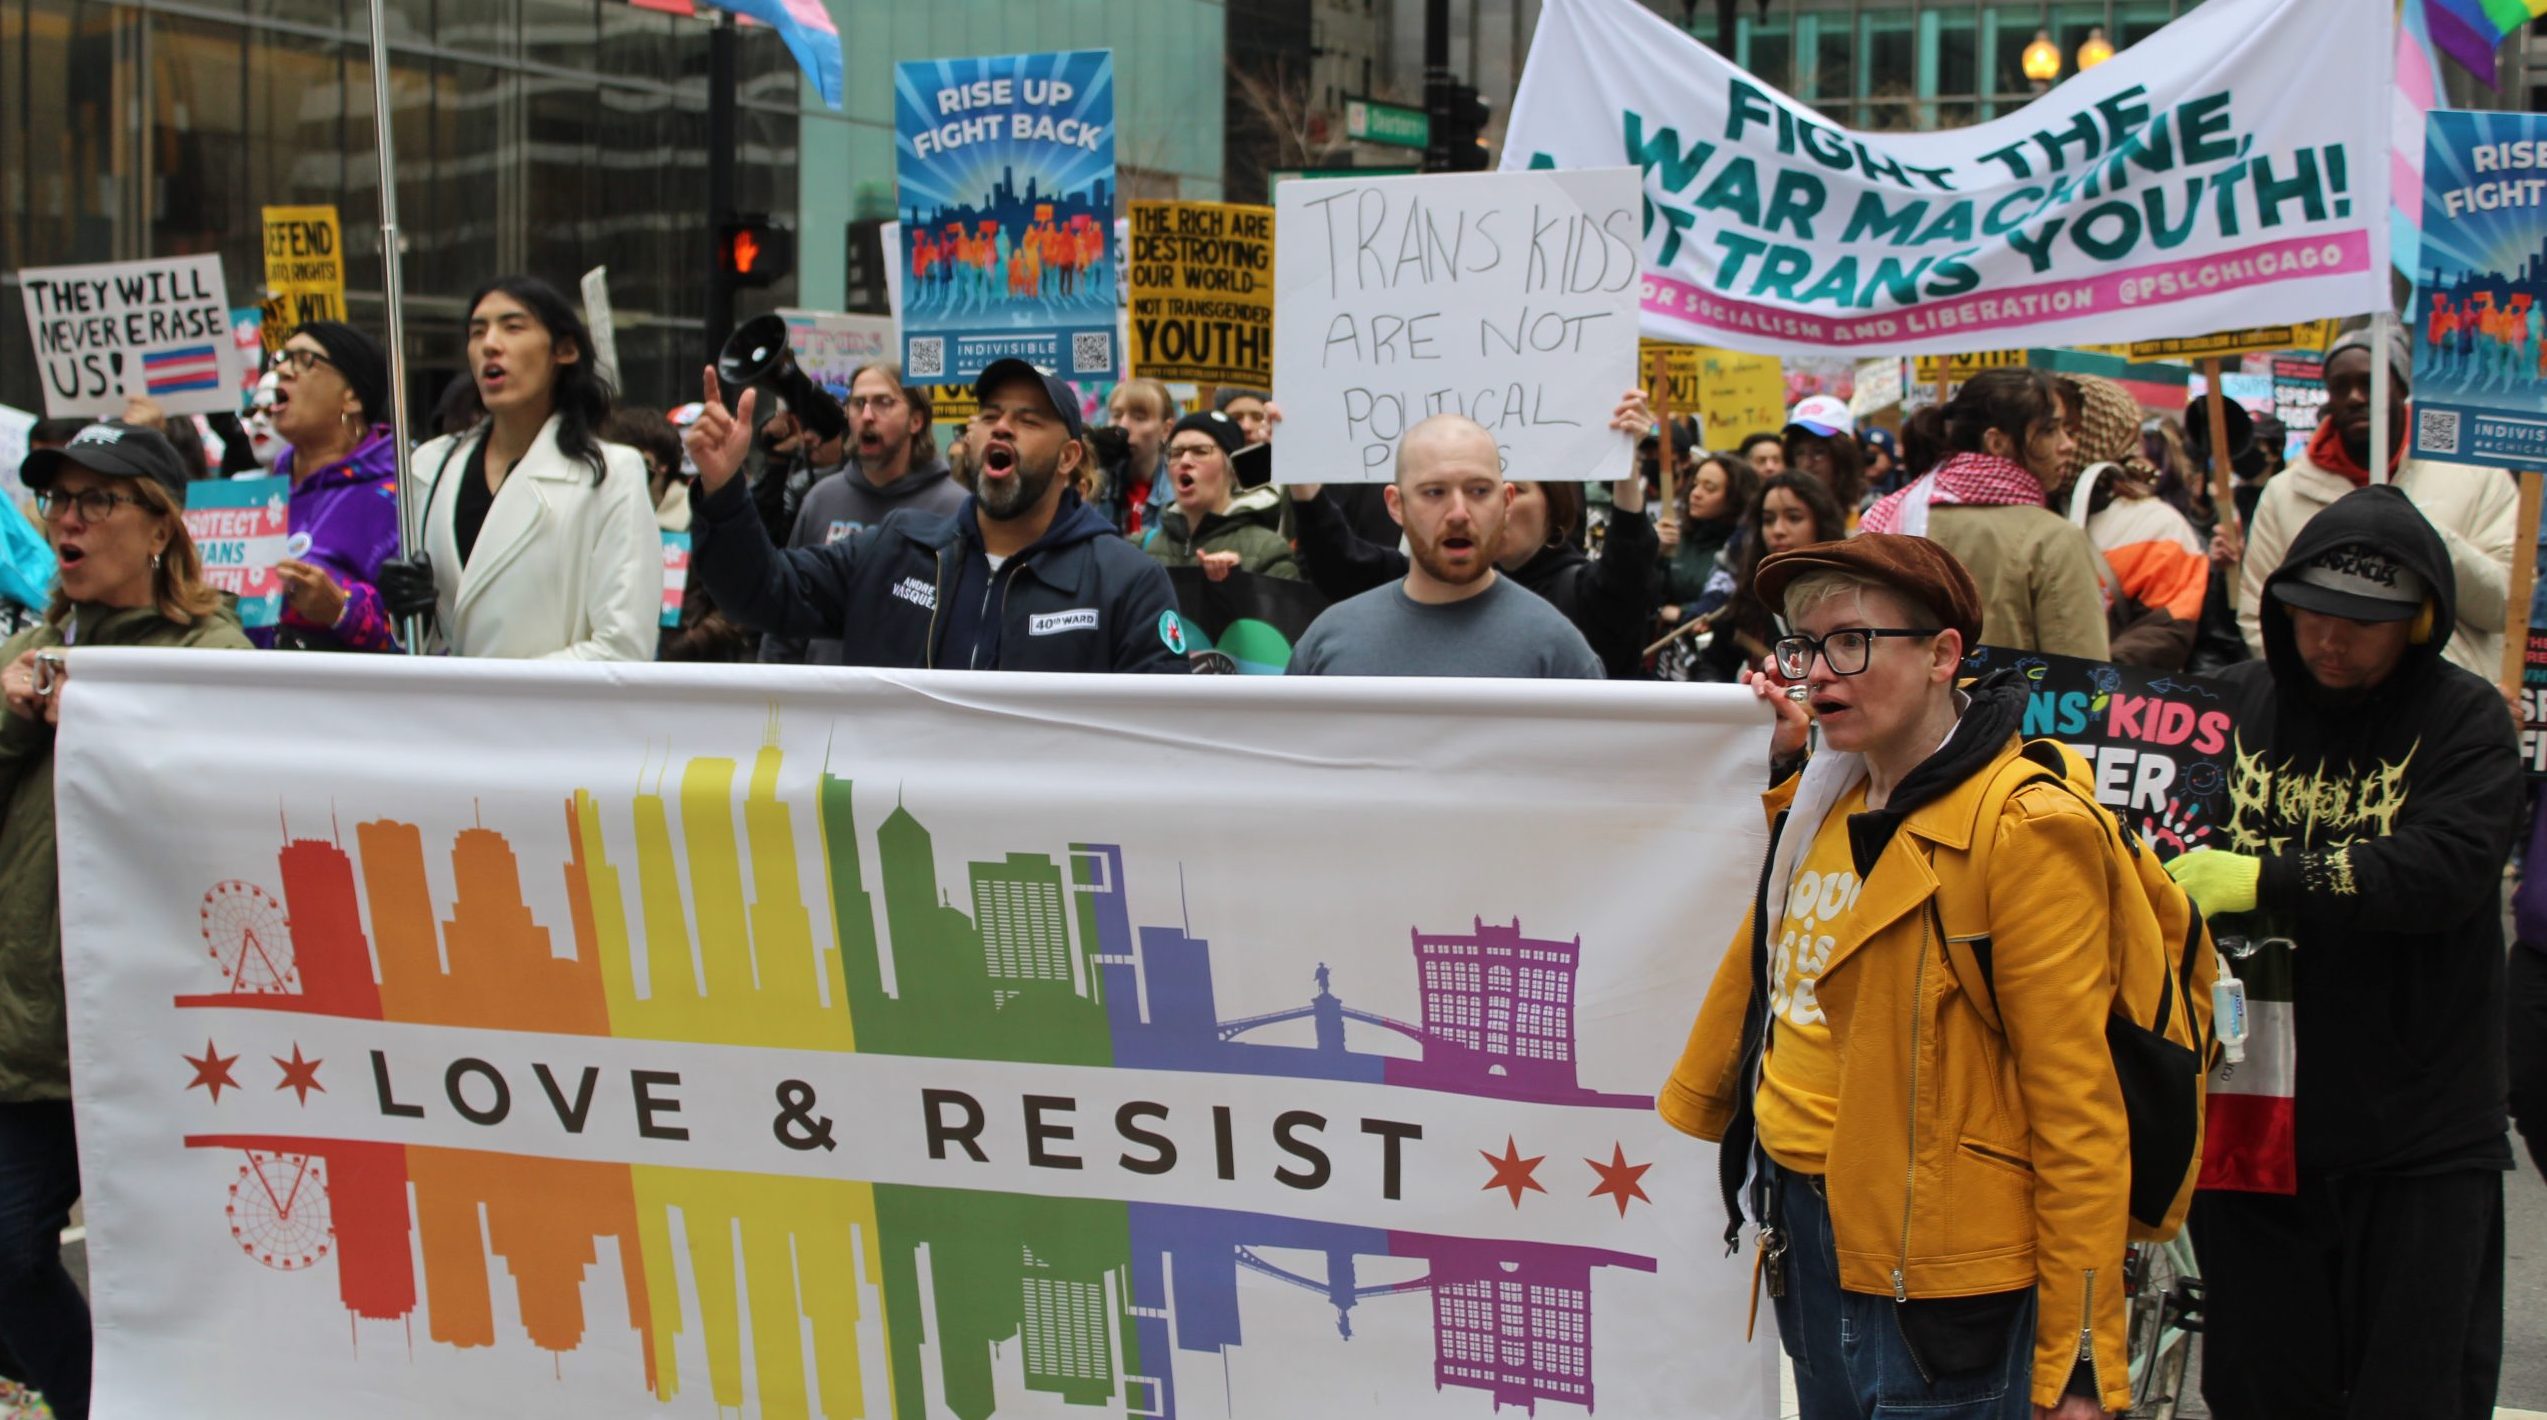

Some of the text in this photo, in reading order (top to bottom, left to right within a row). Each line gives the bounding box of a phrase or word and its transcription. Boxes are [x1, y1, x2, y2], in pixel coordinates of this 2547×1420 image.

[937, 79, 1074, 116] RISE UP
[913, 113, 1103, 160] FIGHT BACK
[1724, 78, 2150, 190] FIGHT THE
[1623, 108, 1827, 240] WAR
[1839, 89, 2254, 247] MACHINE,
[2443, 179, 2547, 219] FIGHT
[1134, 207, 1270, 240] THE RICH ARE
[1304, 188, 1501, 299] TRANS
[1525, 204, 1637, 295] KIDS
[1712, 144, 2352, 309] TRANS YOUTH!
[1133, 265, 1174, 288] OUR
[1134, 236, 1269, 270] DESTROYING
[26, 268, 211, 315] THEY WILL
[1134, 298, 1271, 324] NOT TRANSGENDER
[1640, 244, 2343, 342] OR SOCIALISM AND LIBERATION @PSLCHICAGO
[39, 316, 121, 354] NEVER
[124, 306, 224, 346] ERASE
[958, 342, 1057, 357] INDIVISIBLE
[1136, 318, 1271, 372] YOUTH!
[1322, 306, 1613, 369] ARE NOT
[48, 352, 125, 400] US!
[2474, 423, 2547, 442] INDIVIS
[903, 576, 936, 598] ANDRE
[1036, 614, 1094, 630] 40th WARD
[2107, 693, 2231, 755] KIDS
[369, 1050, 1423, 1201] LOVE & RESIST
